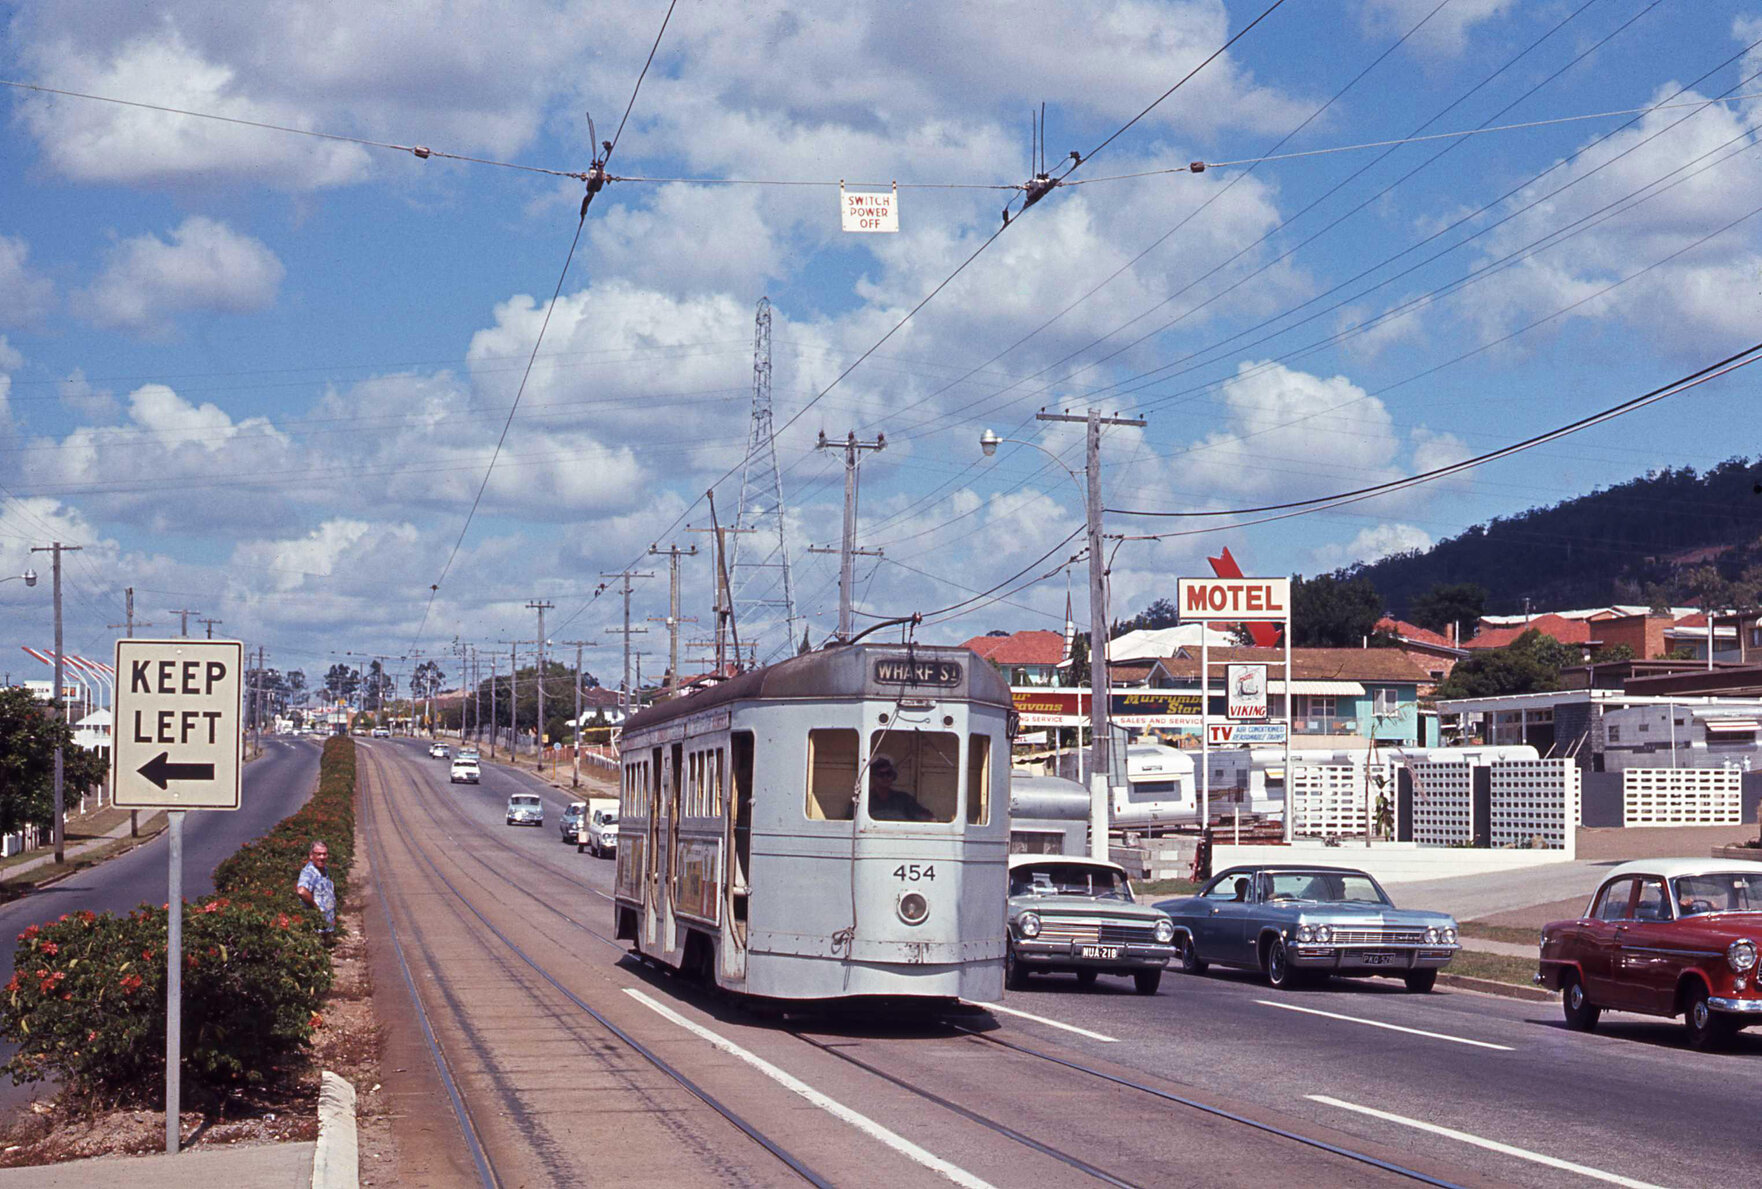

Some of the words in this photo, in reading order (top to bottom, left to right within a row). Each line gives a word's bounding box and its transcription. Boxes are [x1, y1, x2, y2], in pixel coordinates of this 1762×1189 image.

[848, 196, 889, 206] SWITCH
[850, 207, 888, 217] POWER
[860, 218, 880, 229] OFF
[1187, 585, 1283, 611] MOTEL
[131, 660, 226, 695] KEEP
[878, 663, 934, 680] WHARF
[1166, 702, 1202, 714] Star
[1230, 705, 1266, 716] VIKING
[134, 710, 222, 744] LEFT
[1211, 727, 1233, 740] TV
[893, 865, 936, 881] 454
